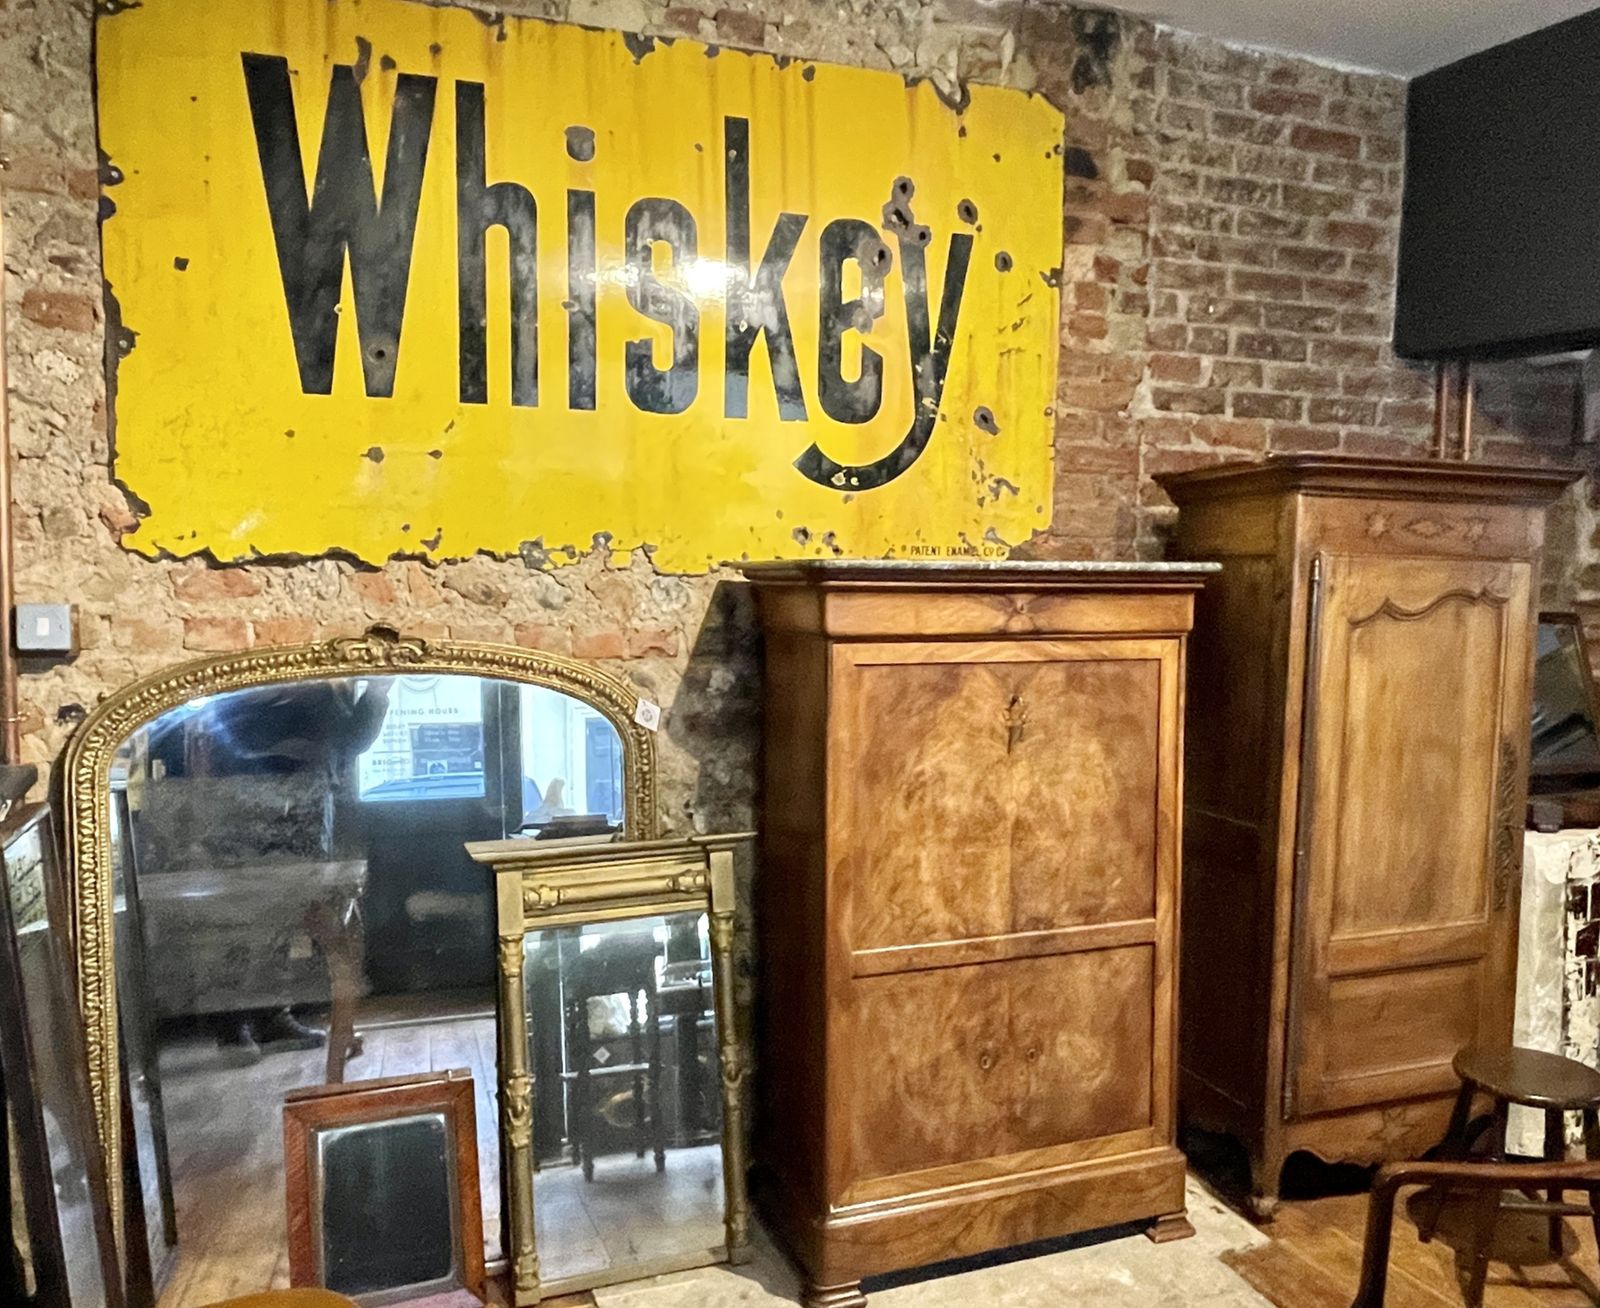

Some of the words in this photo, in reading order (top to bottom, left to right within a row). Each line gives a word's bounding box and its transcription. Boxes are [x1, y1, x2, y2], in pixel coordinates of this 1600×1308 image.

[241, 51, 973, 491] Whiskey
[910, 545, 941, 556] PATENT
[389, 707, 424, 716] PENING
